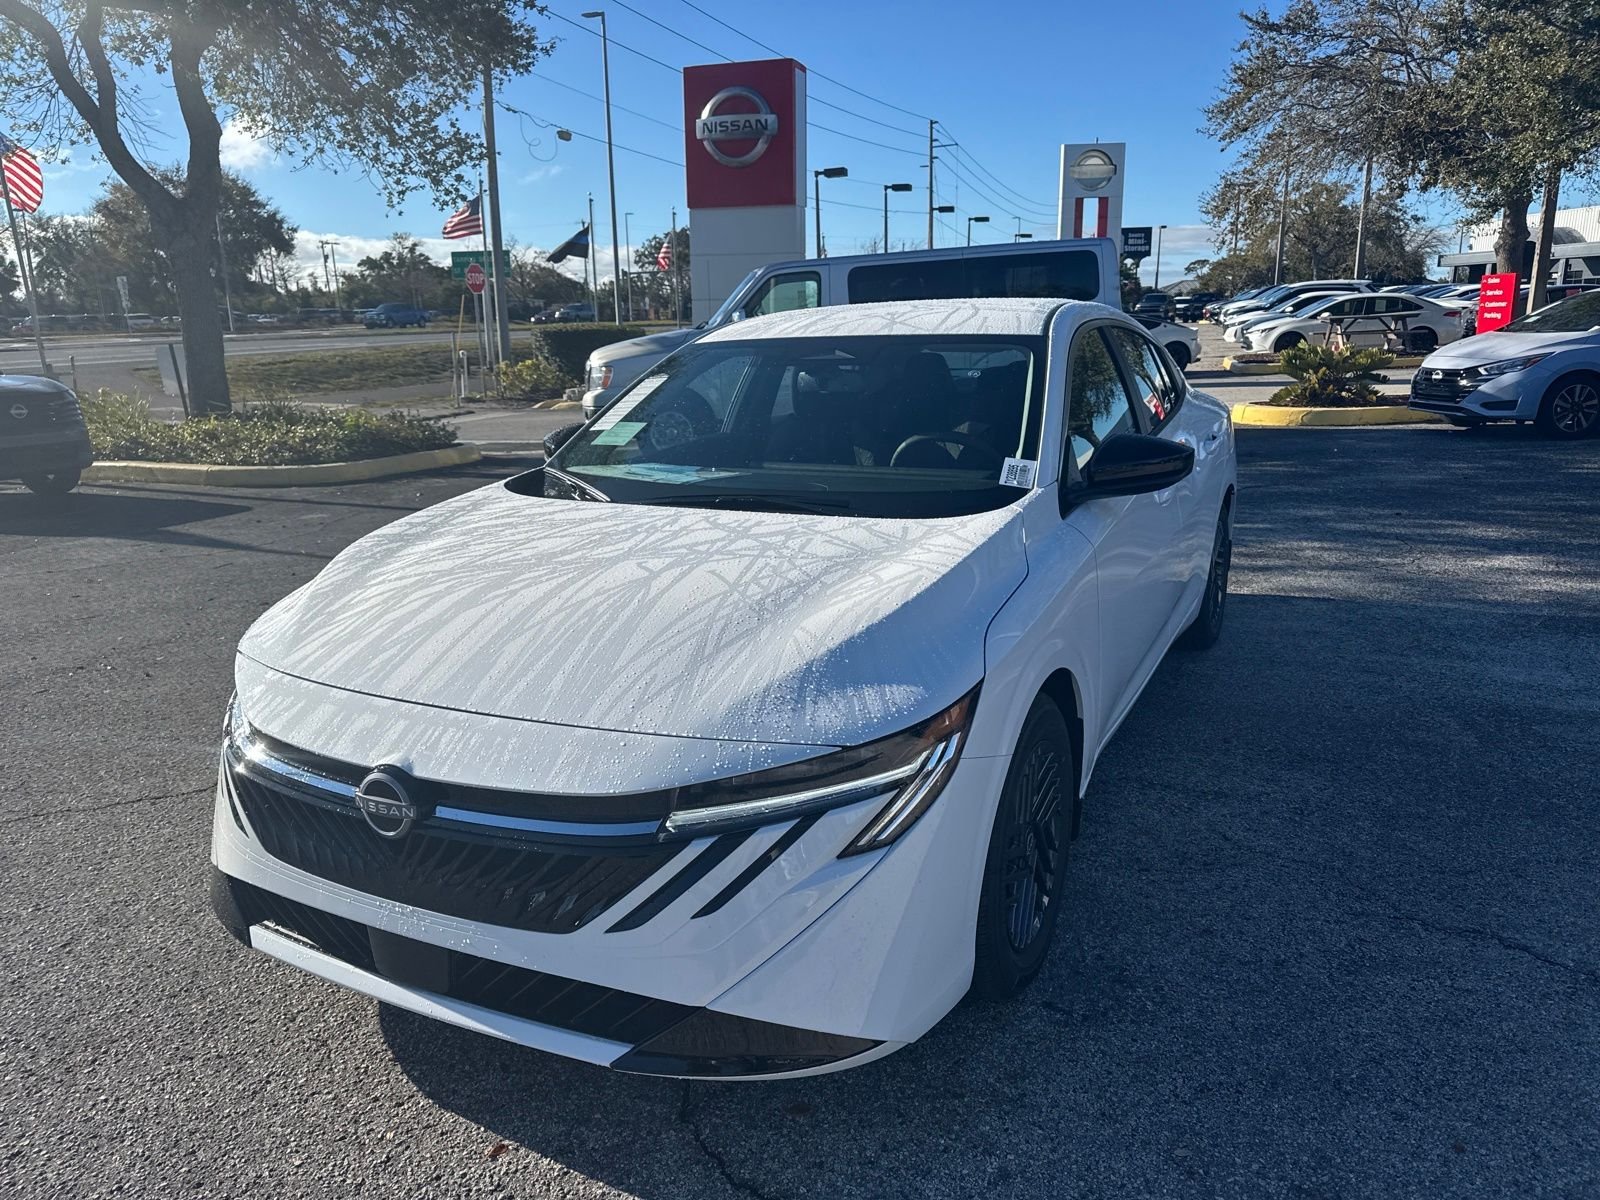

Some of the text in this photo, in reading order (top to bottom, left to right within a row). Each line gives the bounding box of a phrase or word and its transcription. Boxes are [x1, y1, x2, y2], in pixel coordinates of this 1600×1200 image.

[702, 118, 769, 134] NISSAN
[467, 273, 485, 285] STOP
[355, 796, 414, 817] NISSAN
